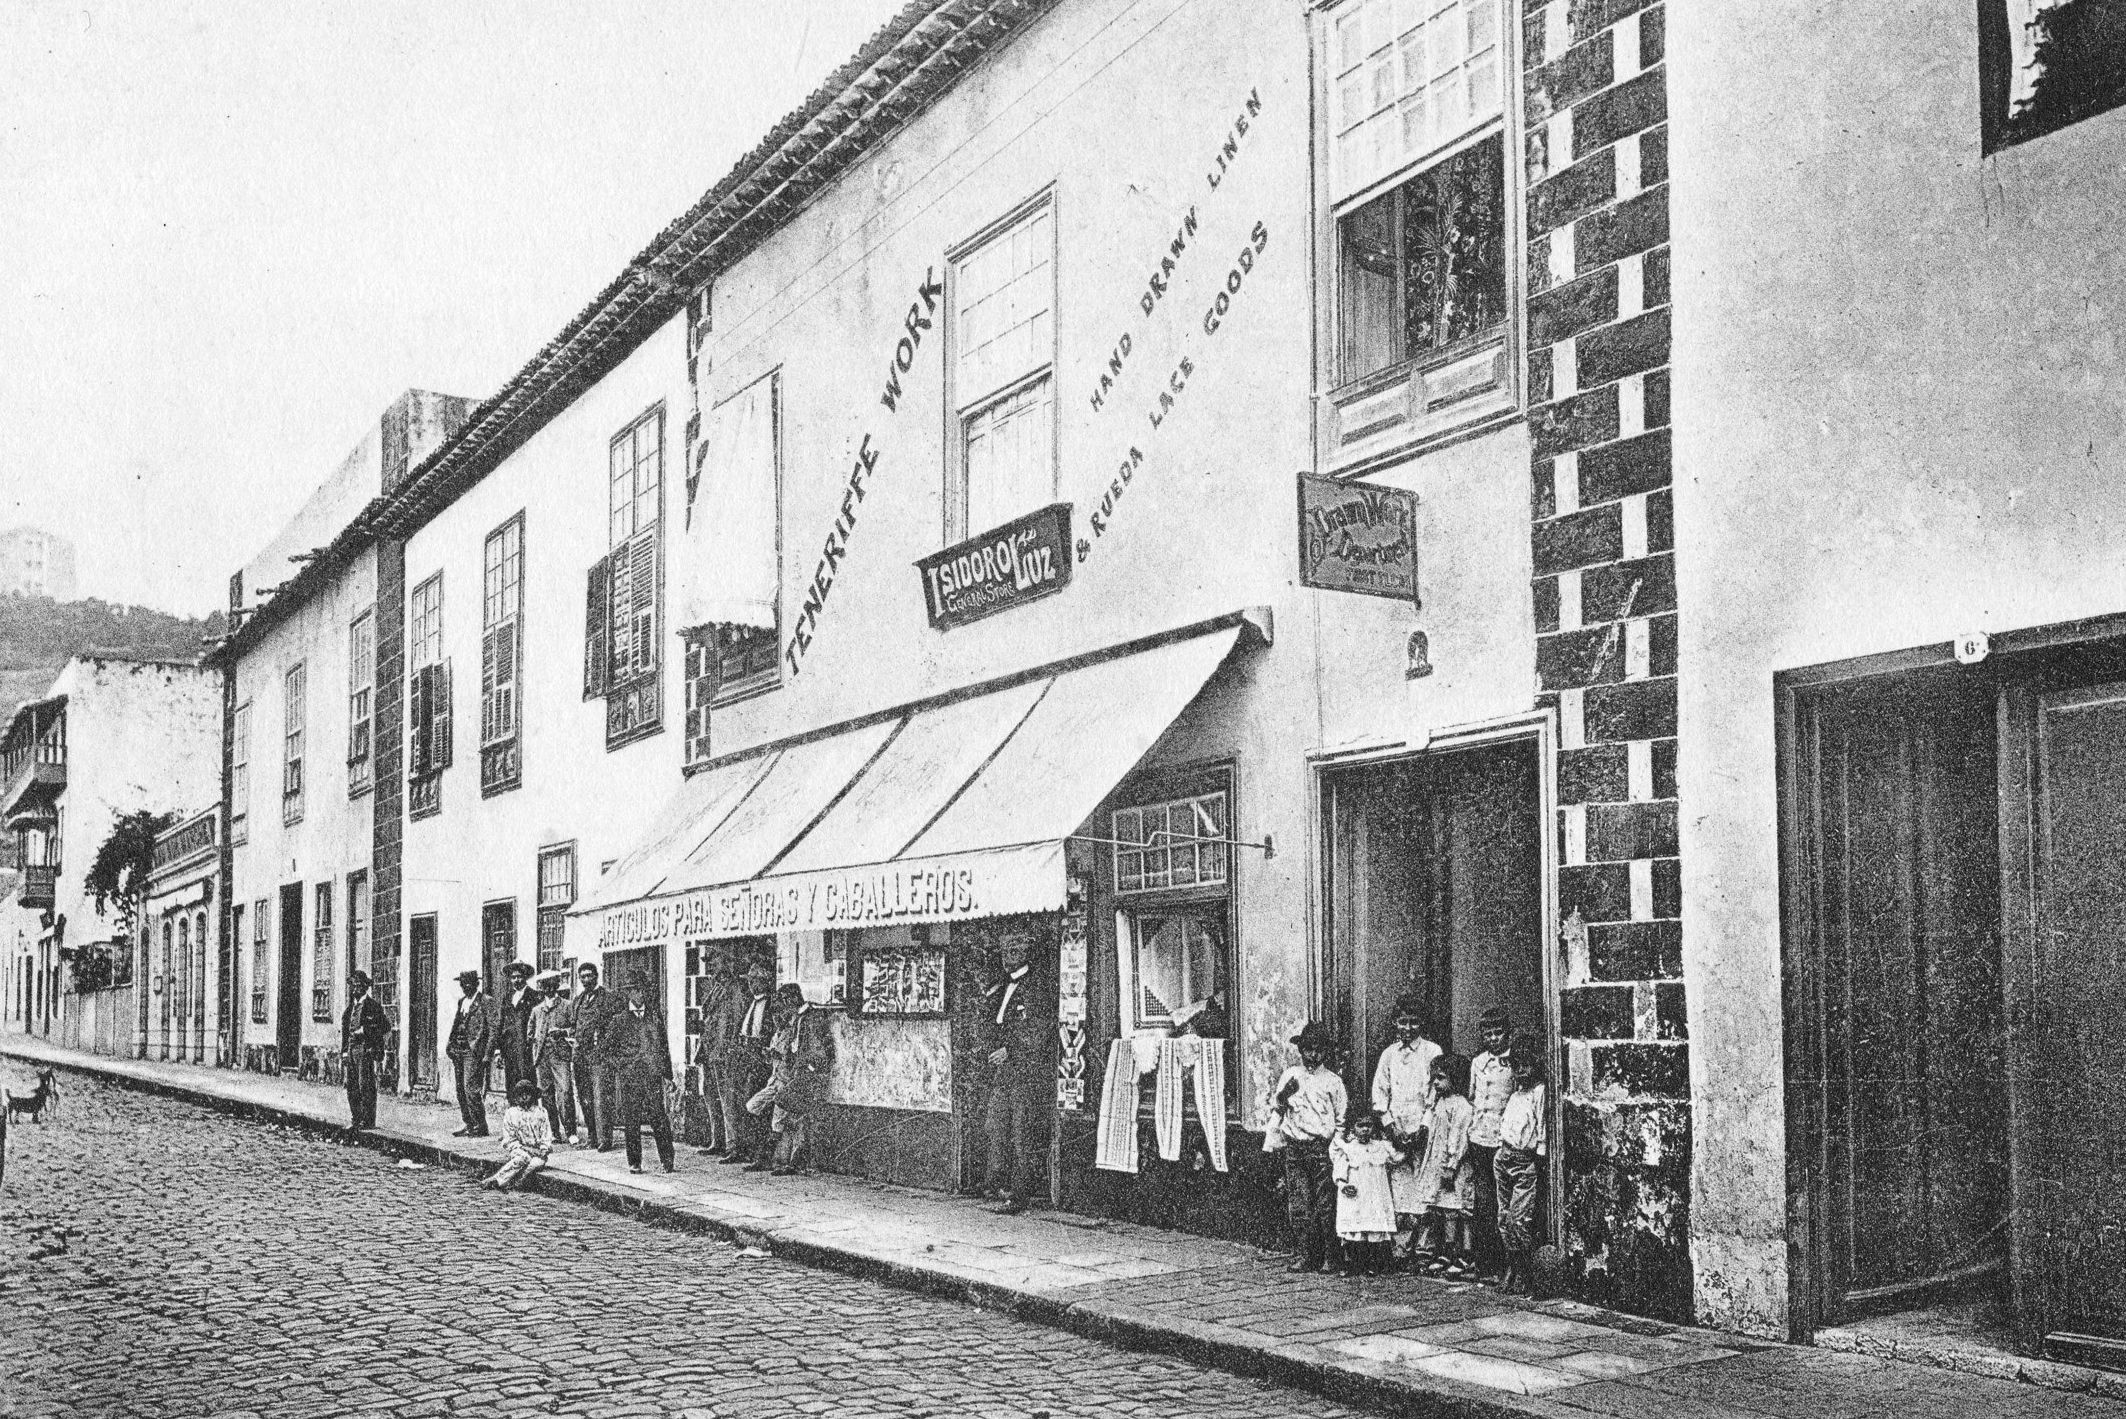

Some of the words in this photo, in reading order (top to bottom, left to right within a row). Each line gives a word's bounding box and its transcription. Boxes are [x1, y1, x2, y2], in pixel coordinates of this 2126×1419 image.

[1090, 332, 1132, 412] HAND
[1140, 205, 1198, 318] DRAWN
[1207, 86, 1262, 192] LINEN
[1090, 446, 1143, 538] RUEDA
[1149, 356, 1195, 430] LACE
[1203, 220, 1268, 336] GOODS
[785, 432, 880, 676] TENERIFFE
[880, 265, 943, 414] WORK
[928, 541, 1012, 619] ISIDORO
[1008, 533, 1056, 591] LUZ
[599, 905, 669, 948] ARTICULOS
[673, 896, 713, 936] PARA
[721, 885, 799, 931] SEÑORAS
[808, 881, 818, 923] Y
